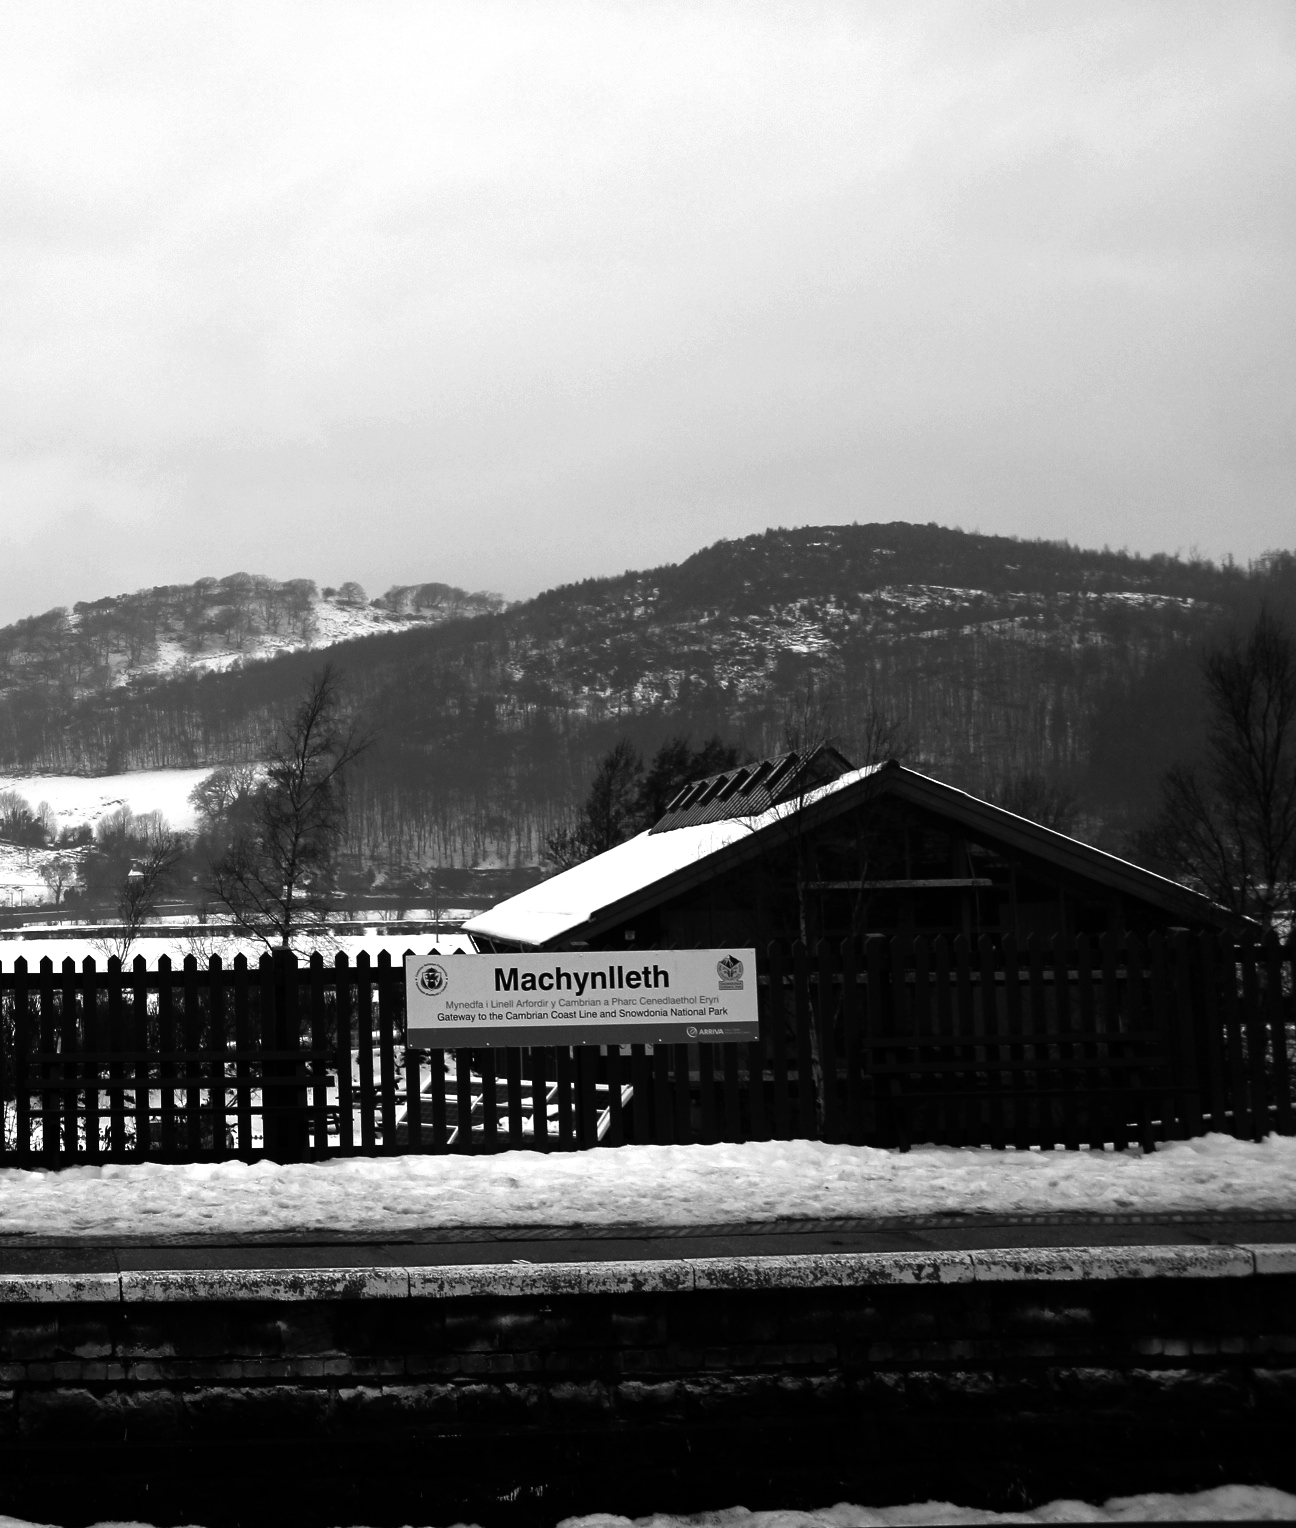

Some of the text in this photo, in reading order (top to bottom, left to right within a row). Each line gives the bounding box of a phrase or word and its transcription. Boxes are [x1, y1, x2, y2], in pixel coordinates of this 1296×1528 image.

[494, 965, 671, 996] Machynlleth
[445, 1000, 484, 1011] Mynedfa
[490, 999, 514, 1009] Linell
[515, 998, 549, 1008] Arfordir
[550, 1000, 557, 1009] y
[558, 997, 602, 1007] Cambrian
[603, 999, 610, 1007] a
[611, 997, 637, 1006] Pharc
[639, 996, 697, 1006] Cenedlaethol
[699, 995, 720, 1006] Eryri
[437, 1006, 728, 1023] Gateway to the Cambrian Coast Line and Snowdonia National Park
[698, 1028, 725, 1036] ARRIVA
